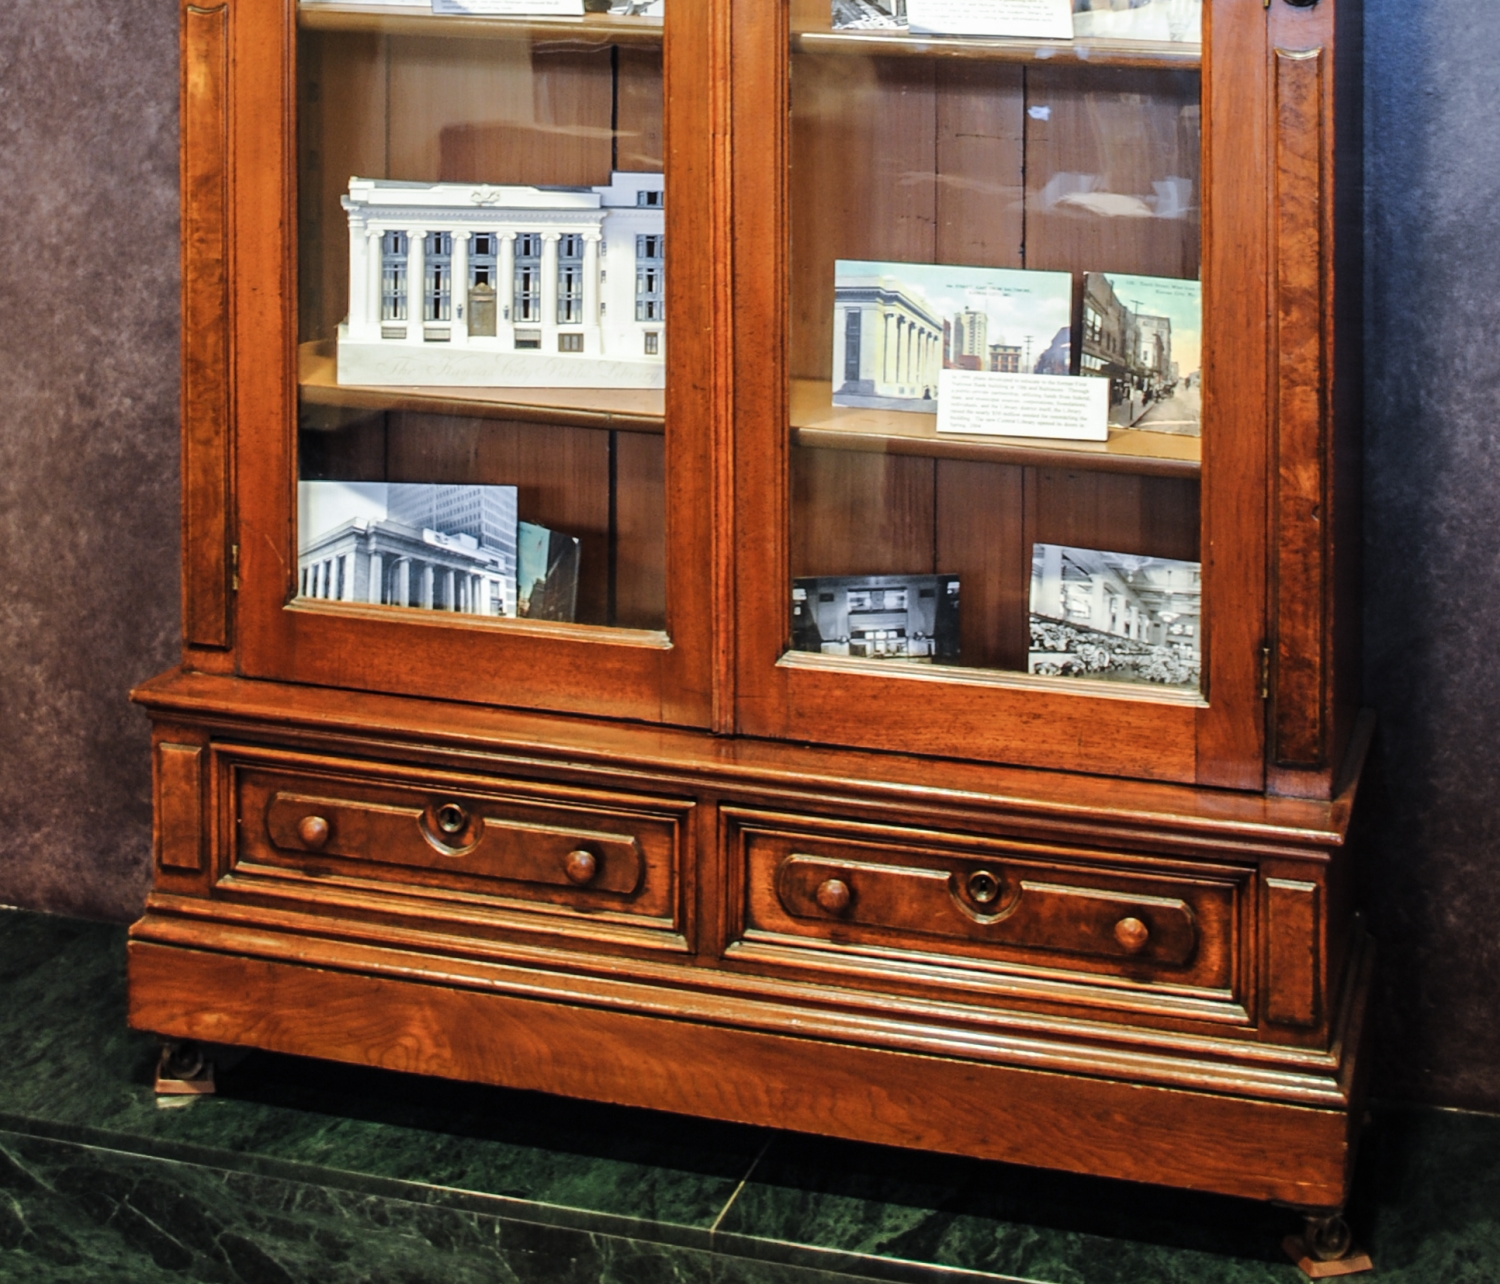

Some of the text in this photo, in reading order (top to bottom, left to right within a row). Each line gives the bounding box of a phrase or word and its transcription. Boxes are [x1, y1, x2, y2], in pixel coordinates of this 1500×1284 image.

[426, 354, 495, 379] Kansas
[495, 353, 533, 383] City
[535, 357, 591, 379] Public
[597, 360, 661, 384] Library
